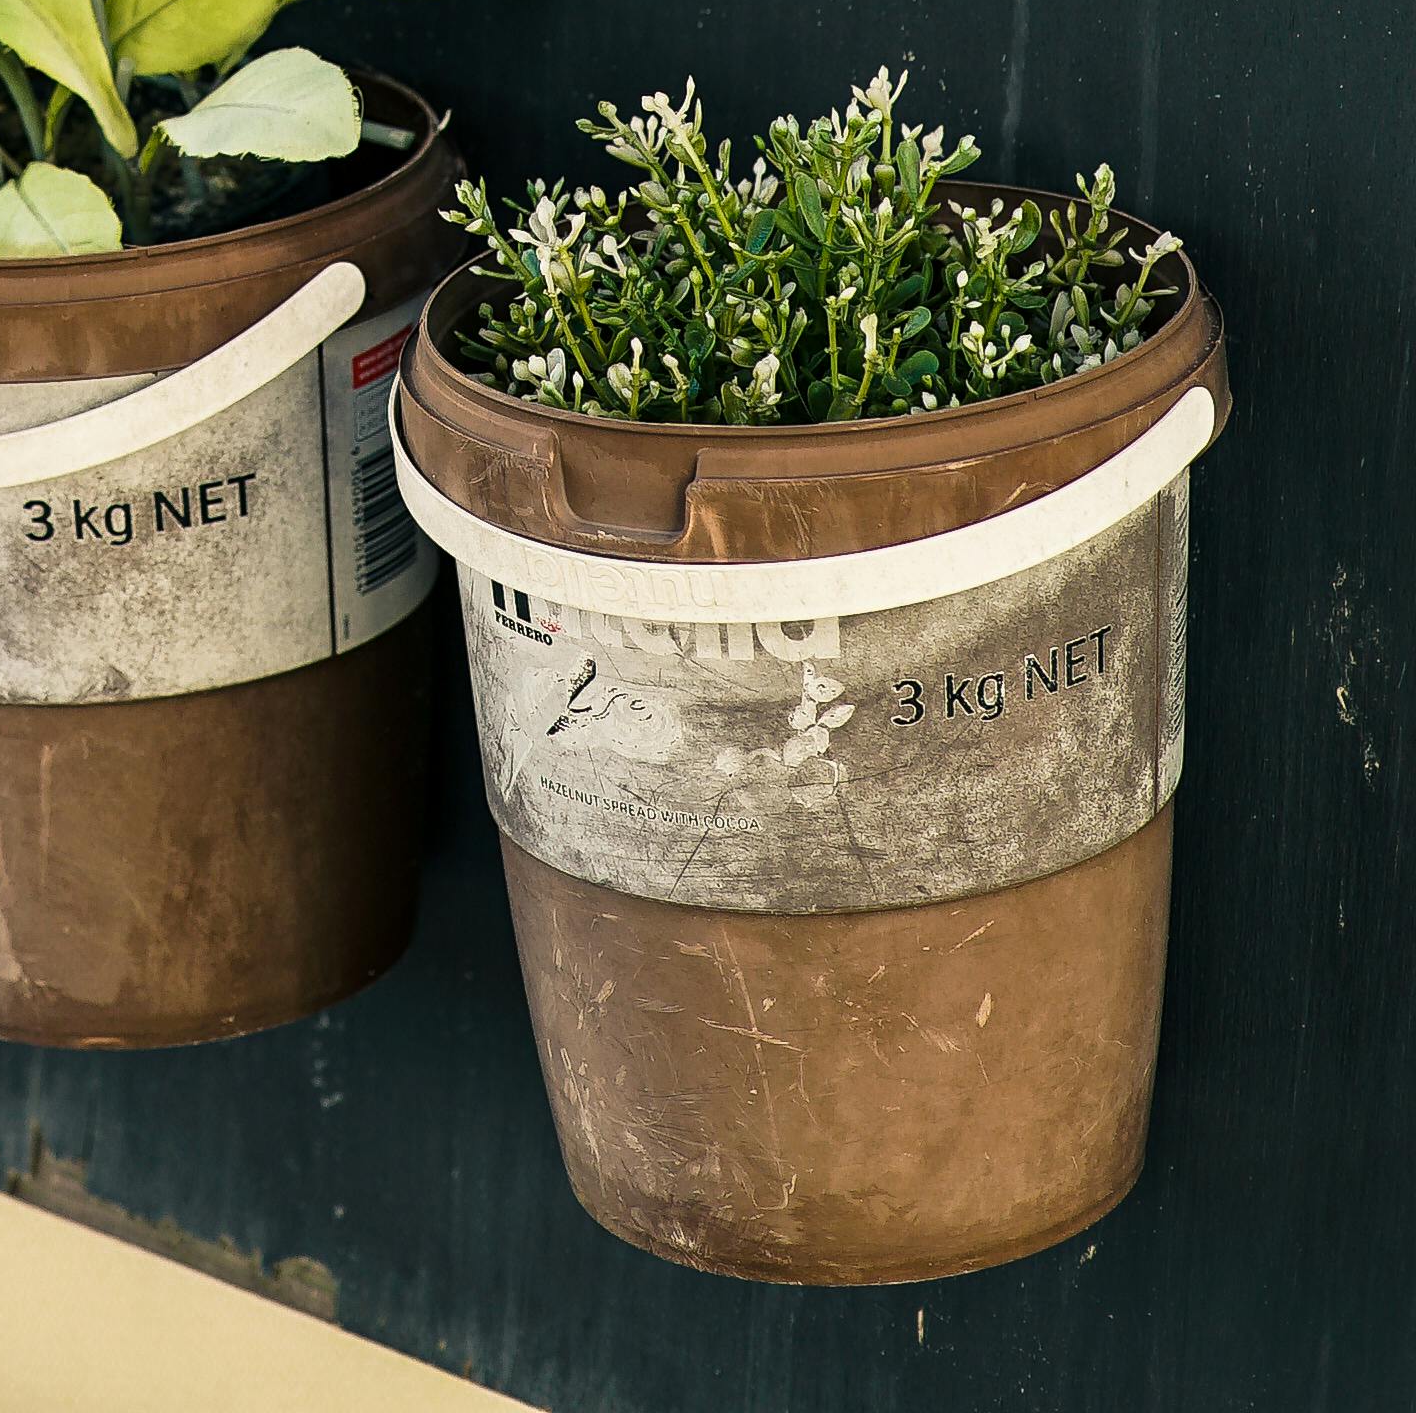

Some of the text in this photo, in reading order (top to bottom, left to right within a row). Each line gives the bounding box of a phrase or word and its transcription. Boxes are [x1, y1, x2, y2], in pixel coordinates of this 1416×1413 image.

[23, 473, 256, 546] 3 kg NET
[494, 609, 553, 646] FERRERO
[891, 625, 1113, 726] 3 kg NET
[540, 776, 599, 807] HAZELNUT
[603, 798, 658, 821] SPREAD
[660, 810, 700, 827] WITH
